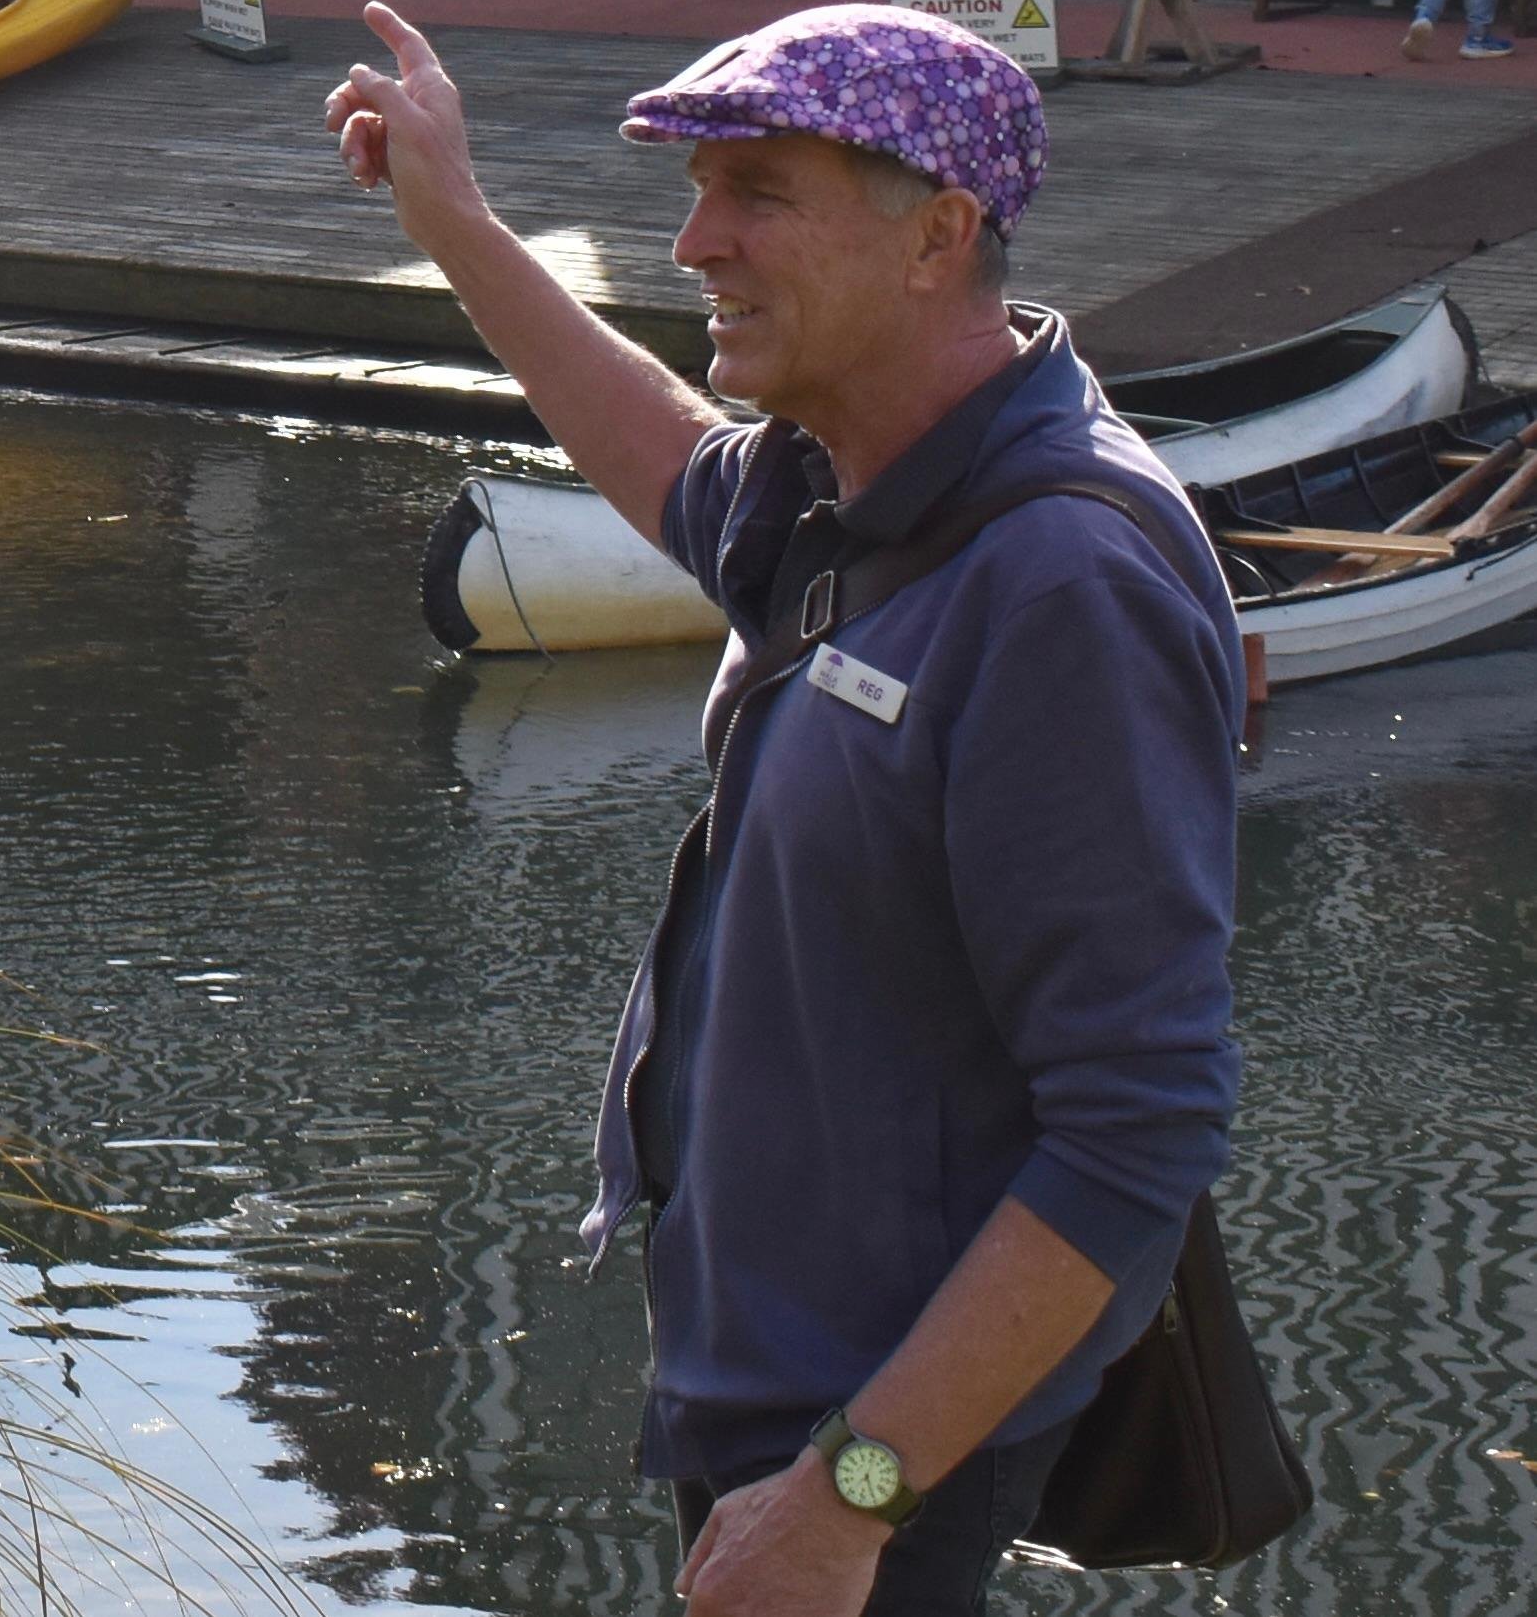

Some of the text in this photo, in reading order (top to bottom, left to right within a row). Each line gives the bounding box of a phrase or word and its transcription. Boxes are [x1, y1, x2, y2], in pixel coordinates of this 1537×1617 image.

[910, 0, 1003, 14] CAUTION
[967, 19, 995, 28] VERY
[993, 33, 1017, 42] WET
[1021, 53, 1046, 62] MATS
[856, 679, 884, 701] REG
